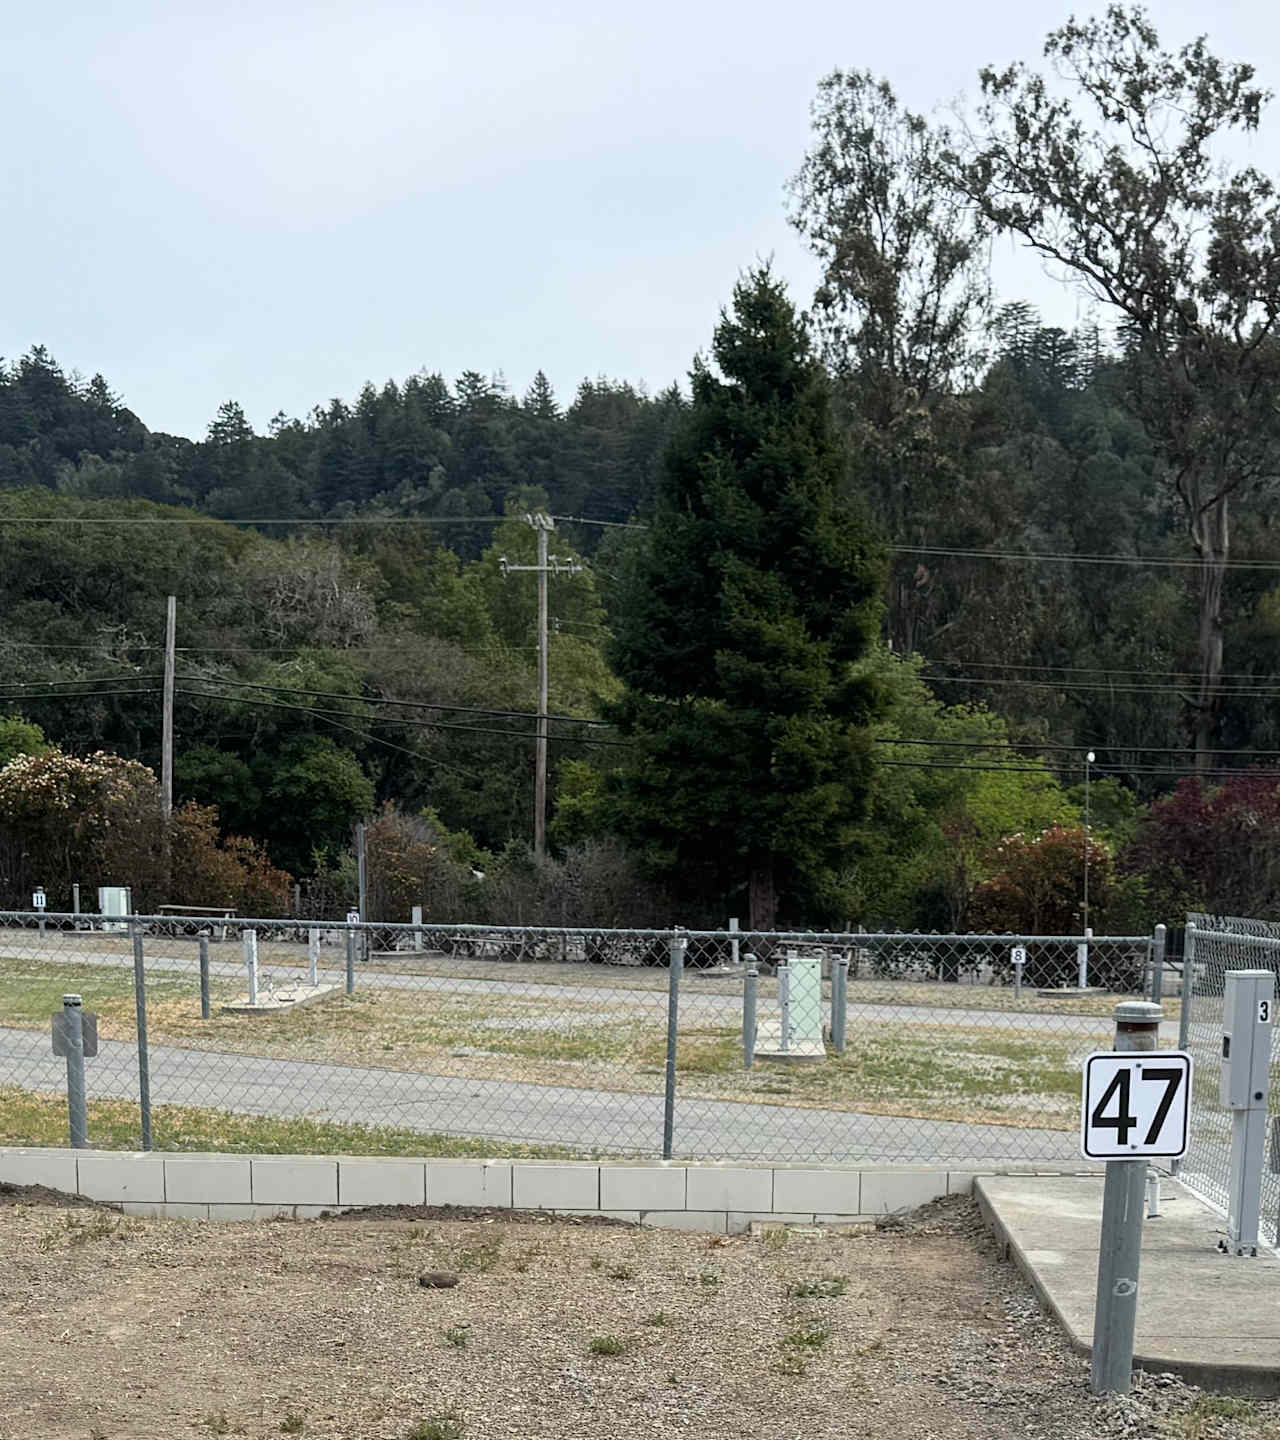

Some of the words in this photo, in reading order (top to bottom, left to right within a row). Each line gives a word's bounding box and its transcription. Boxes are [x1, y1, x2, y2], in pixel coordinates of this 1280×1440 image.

[36, 895, 43, 905] 11
[1015, 950, 1022, 960] 8
[1260, 1001, 1268, 1021] 3
[1091, 1068, 1183, 1145] 47
